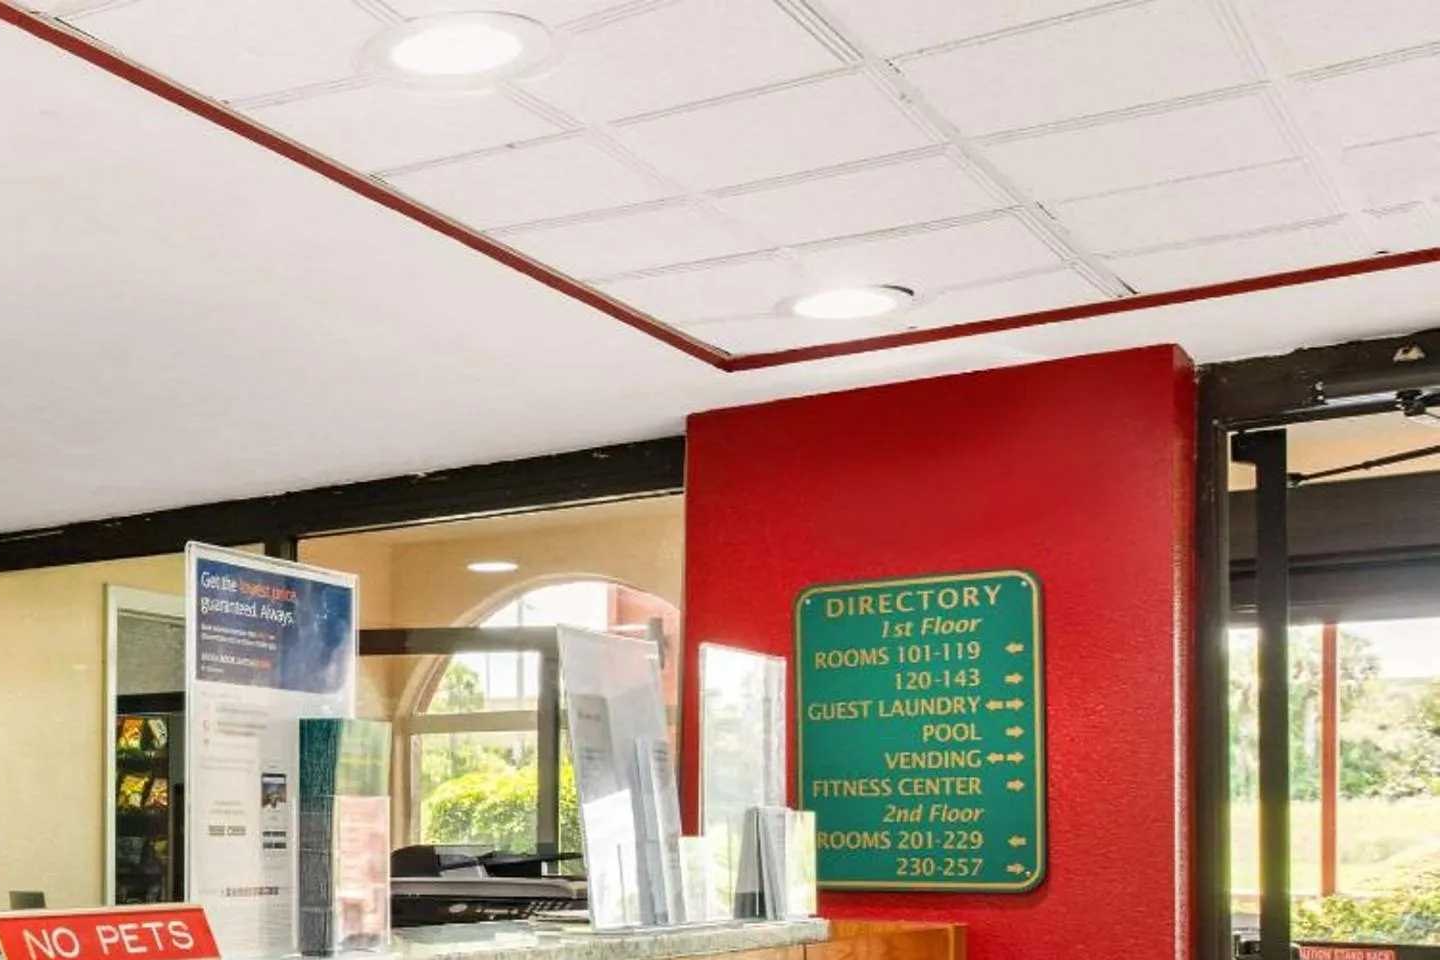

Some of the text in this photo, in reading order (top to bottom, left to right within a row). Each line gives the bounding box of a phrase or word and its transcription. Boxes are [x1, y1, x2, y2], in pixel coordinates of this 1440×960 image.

[826, 584, 1003, 618] DIRECTORY
[881, 616, 983, 638] 1st Floor
[815, 641, 981, 668] ROOMS 101-119
[895, 669, 981, 690] 120-143
[808, 696, 981, 720] GUEST LAUNDRY
[923, 723, 982, 743] POOL
[885, 749, 982, 770] VENDING
[812, 776, 982, 798] FITNESS CENTER
[883, 803, 985, 824] 2nd Floor
[816, 829, 984, 850] ROOMS 201-229
[895, 857, 984, 877] 230-257
[22, 920, 195, 960] NO PETS
[1301, 946, 1332, 960] UTION
